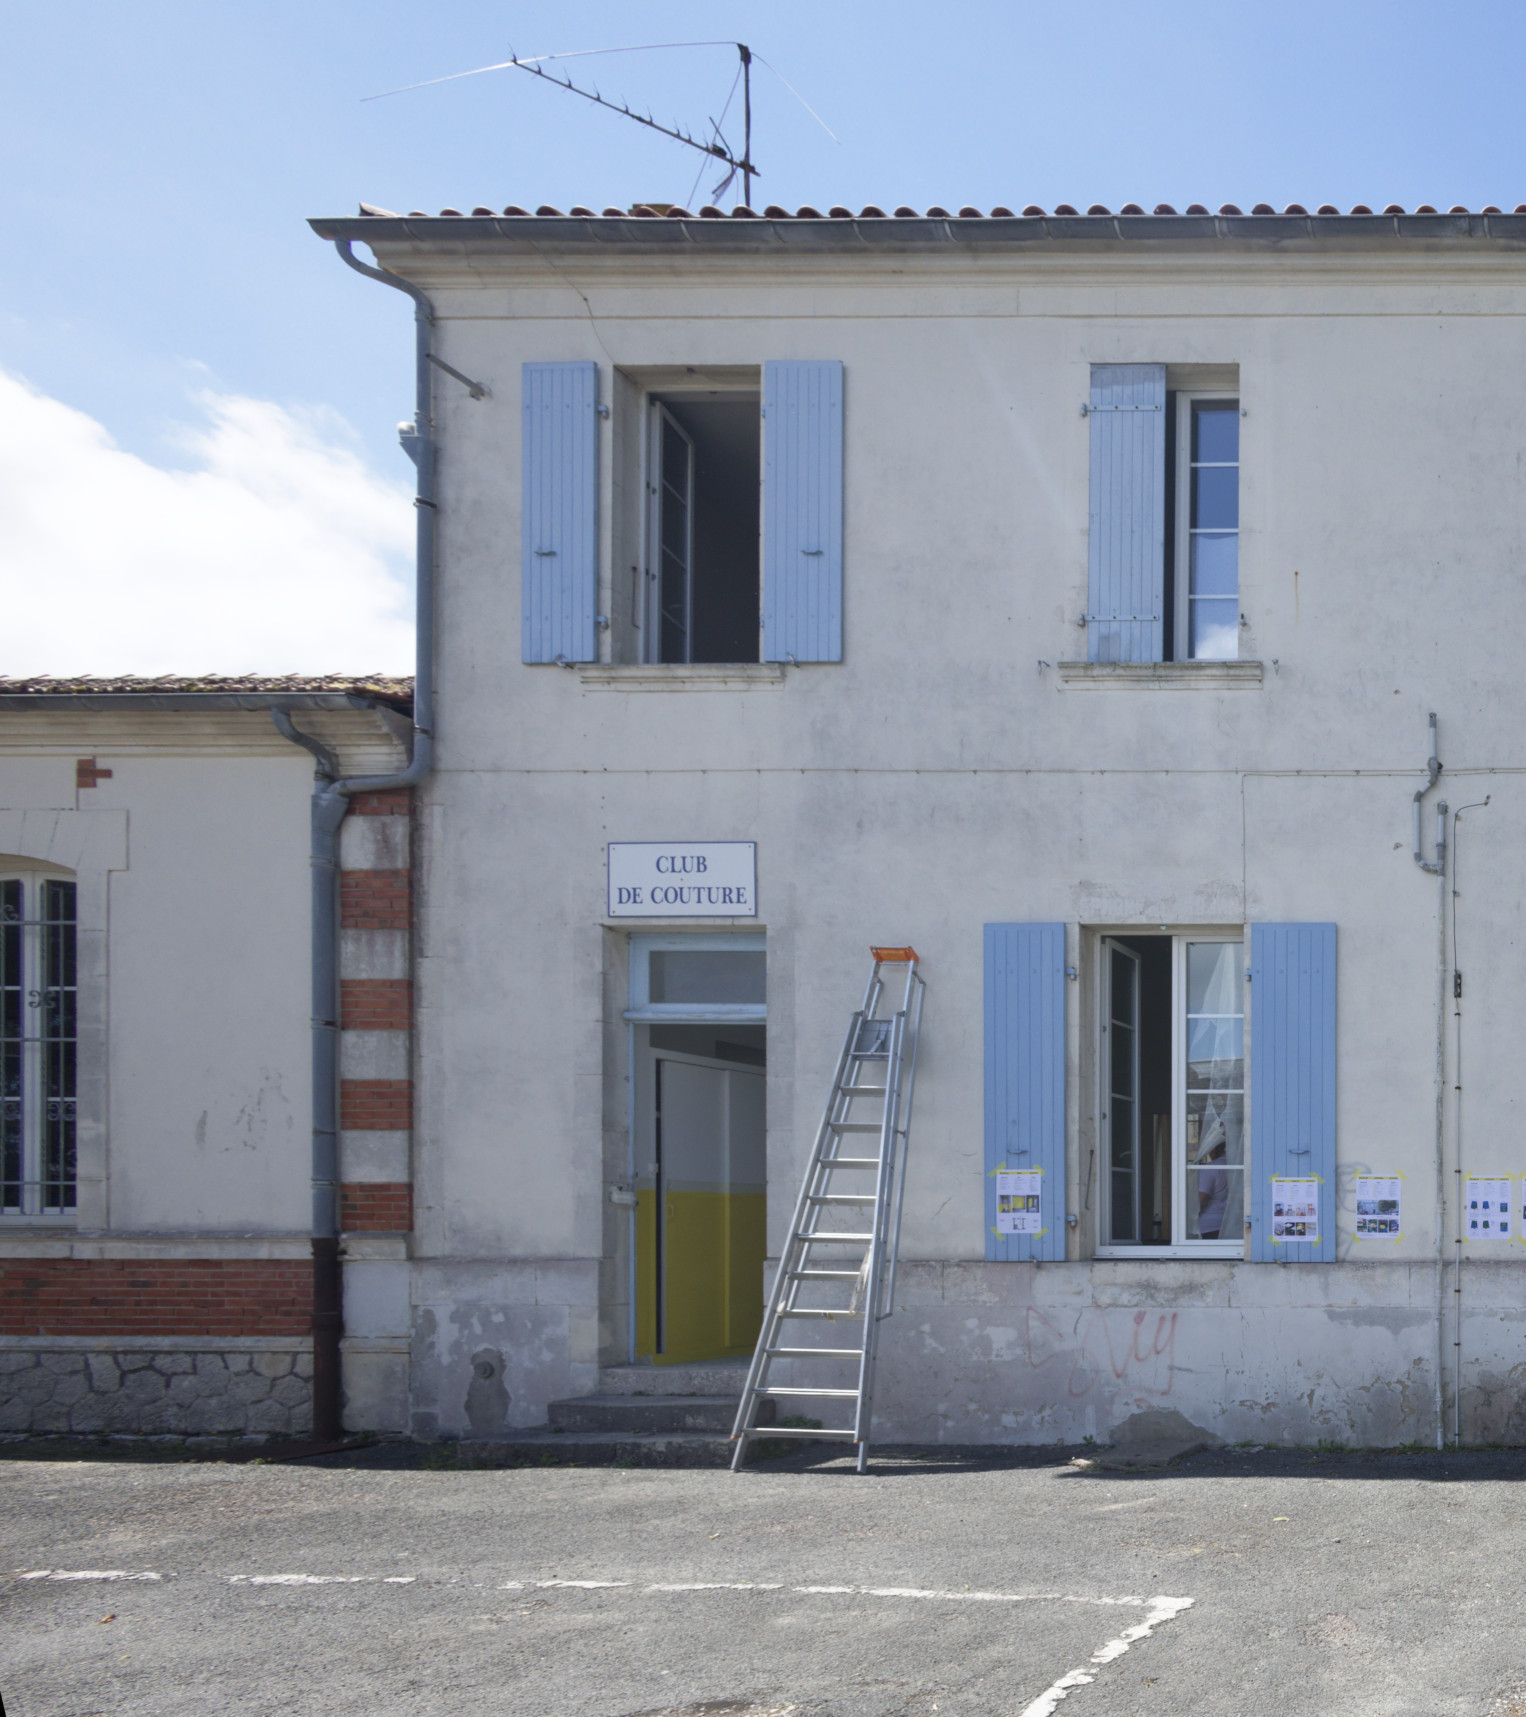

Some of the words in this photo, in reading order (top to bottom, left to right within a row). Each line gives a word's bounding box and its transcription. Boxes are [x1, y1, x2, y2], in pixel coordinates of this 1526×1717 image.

[656, 855, 708, 873] CLUB
[617, 887, 643, 904] DE
[650, 886, 747, 904] COUTURE
